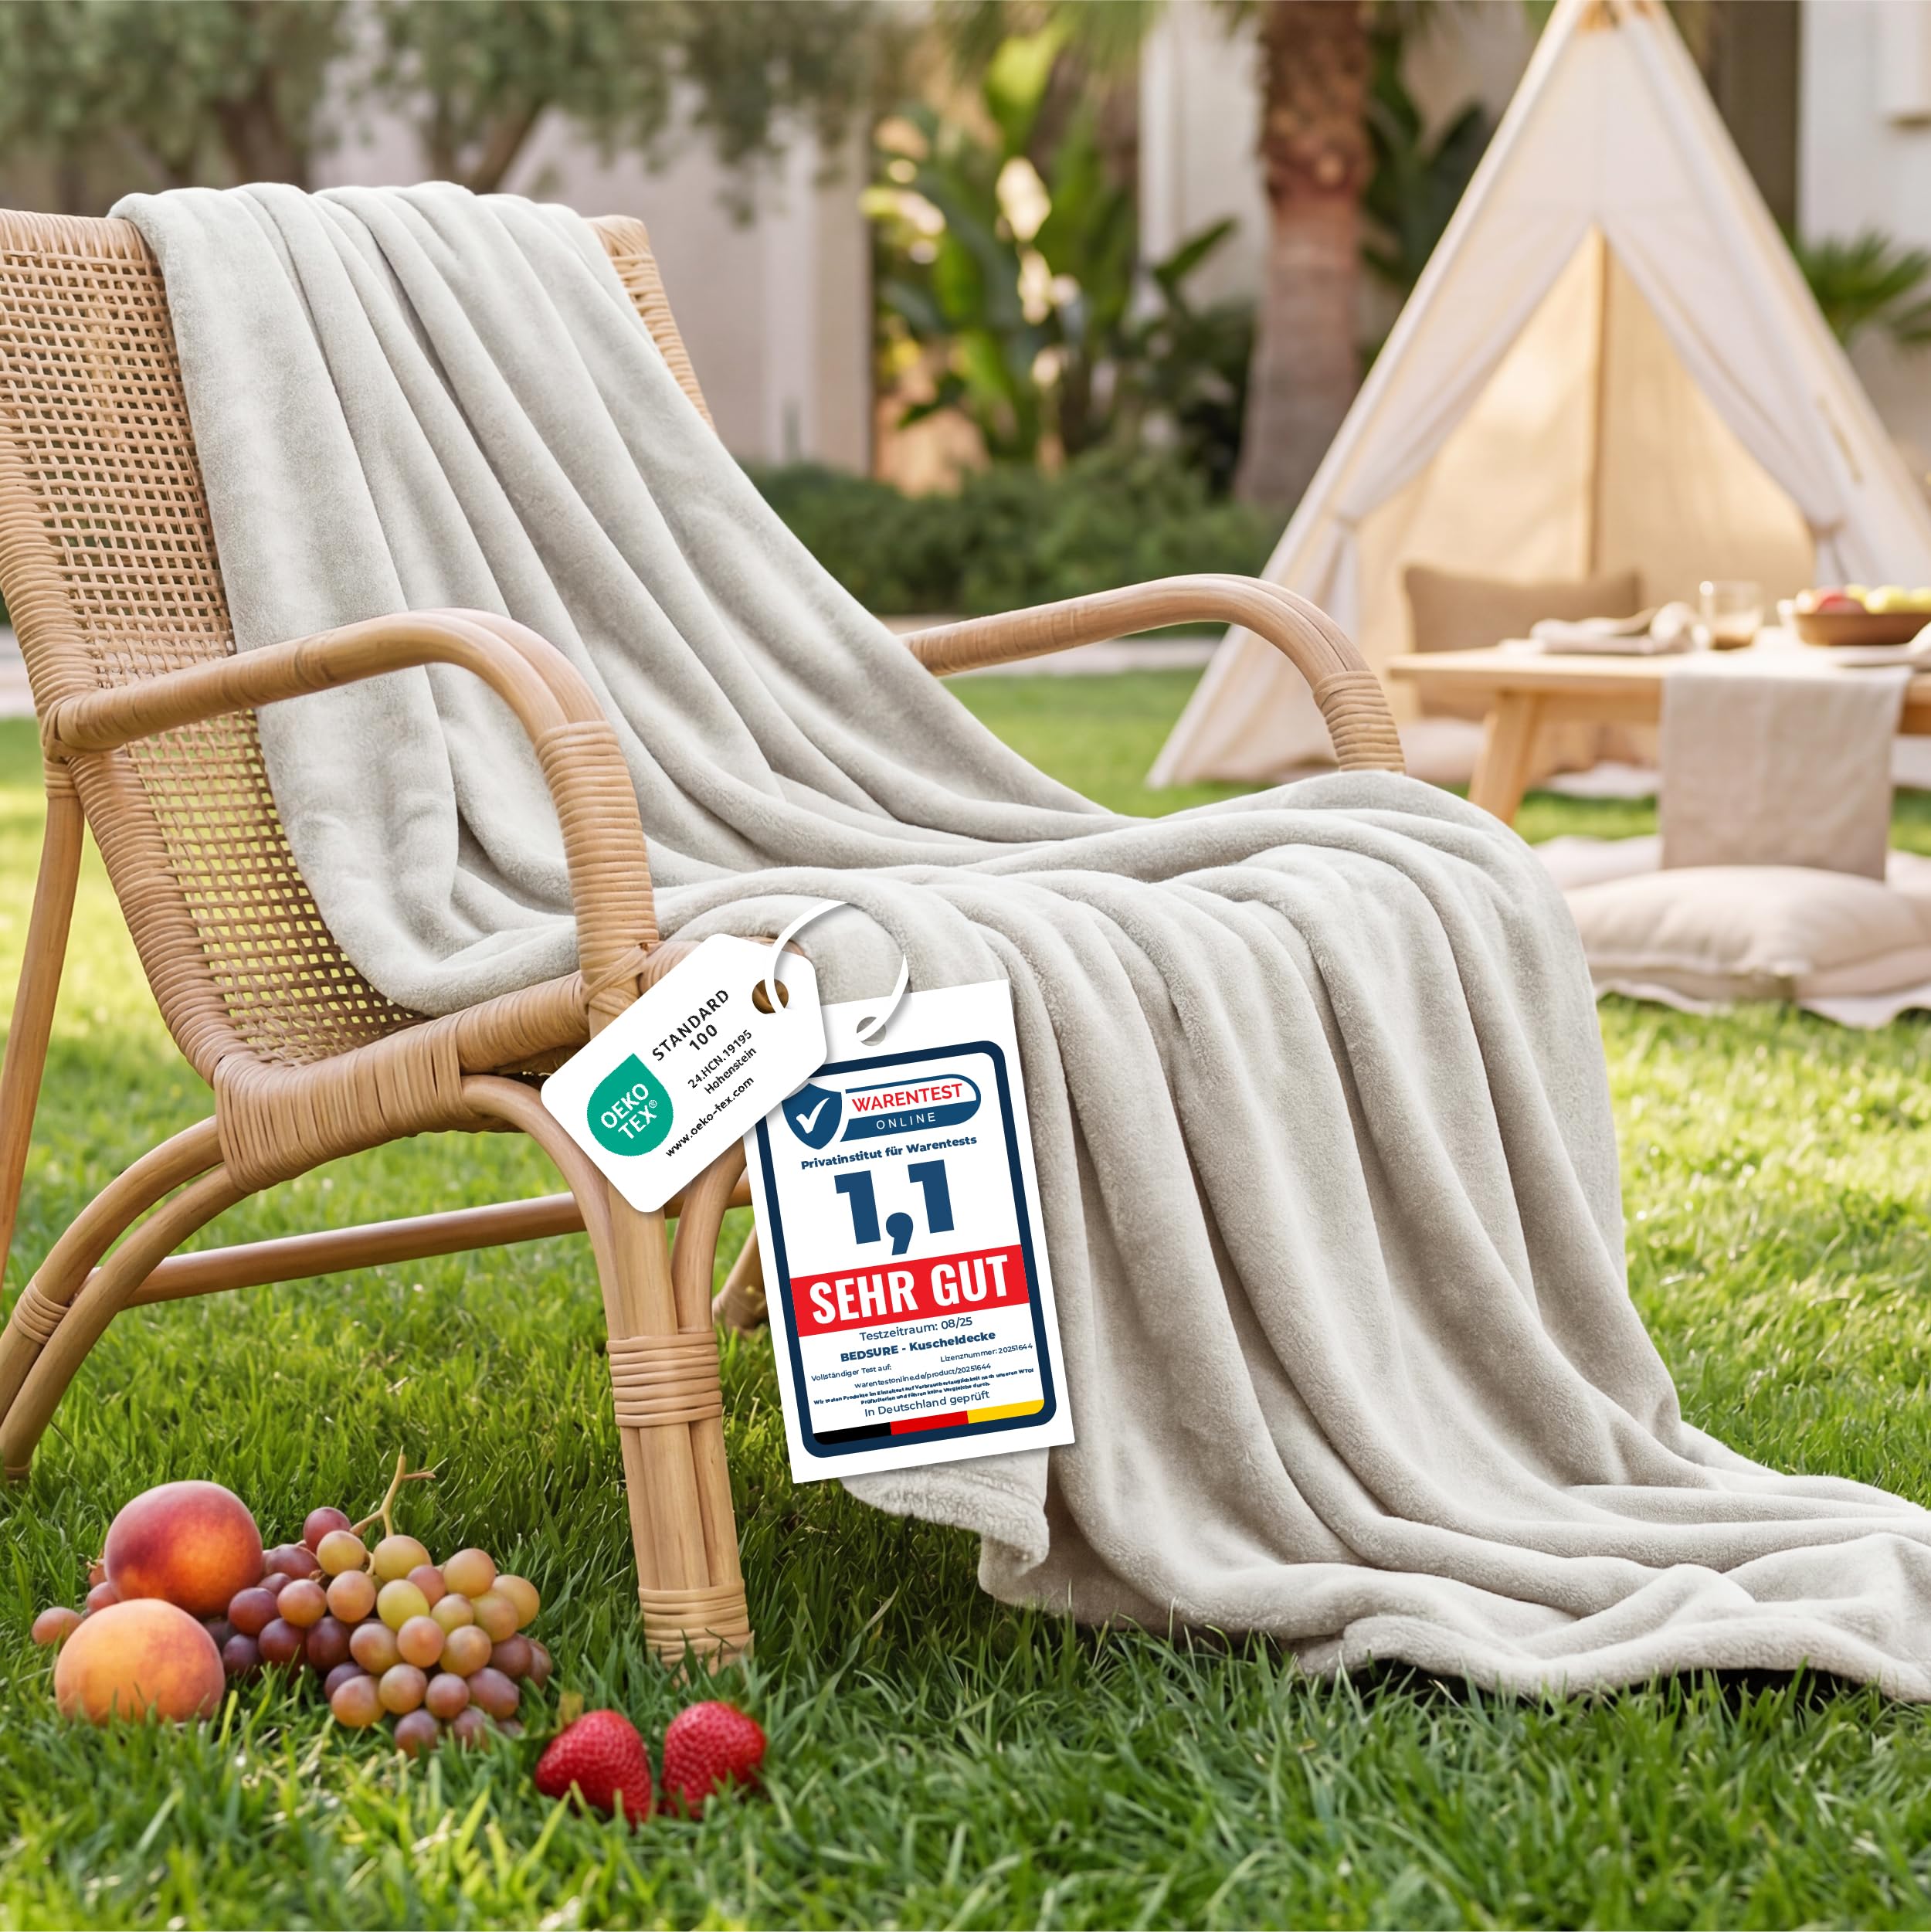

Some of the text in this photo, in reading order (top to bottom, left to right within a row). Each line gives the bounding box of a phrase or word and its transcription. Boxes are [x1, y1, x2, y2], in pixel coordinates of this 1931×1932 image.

[653, 990, 728, 1061] STANDARD
[690, 1024, 717, 1050] 100
[688, 1030, 752, 1088] 24.HCN.19195
[704, 1048, 756, 1094] Hohenstein
[601, 1084, 648, 1128] OEKO
[852, 1083, 962, 1112] WARENTEST
[666, 1078, 754, 1156] www.oeko-tex.com
[877, 1112, 935, 1129] ONLINE
[801, 1137, 977, 1170] Privatinstitut für Warentests
[834, 1160, 954, 1255] 1,1
[810, 1255, 1007, 1323] SEHR GUT
[859, 1317, 972, 1341] Testzeitraum: 08/25
[840, 1345, 898, 1362] BEDSURE
[909, 1333, 996, 1351] Kuscheldecke
[941, 1343, 1033, 1362] Lizenznummer: 20251644
[811, 1370, 859, 1381] Vollständiger
[877, 1363, 892, 1372] auf:
[854, 1363, 991, 1388] warentestonline.de/product/20251644
[864, 1390, 989, 1418] In Deutschland geprüft
